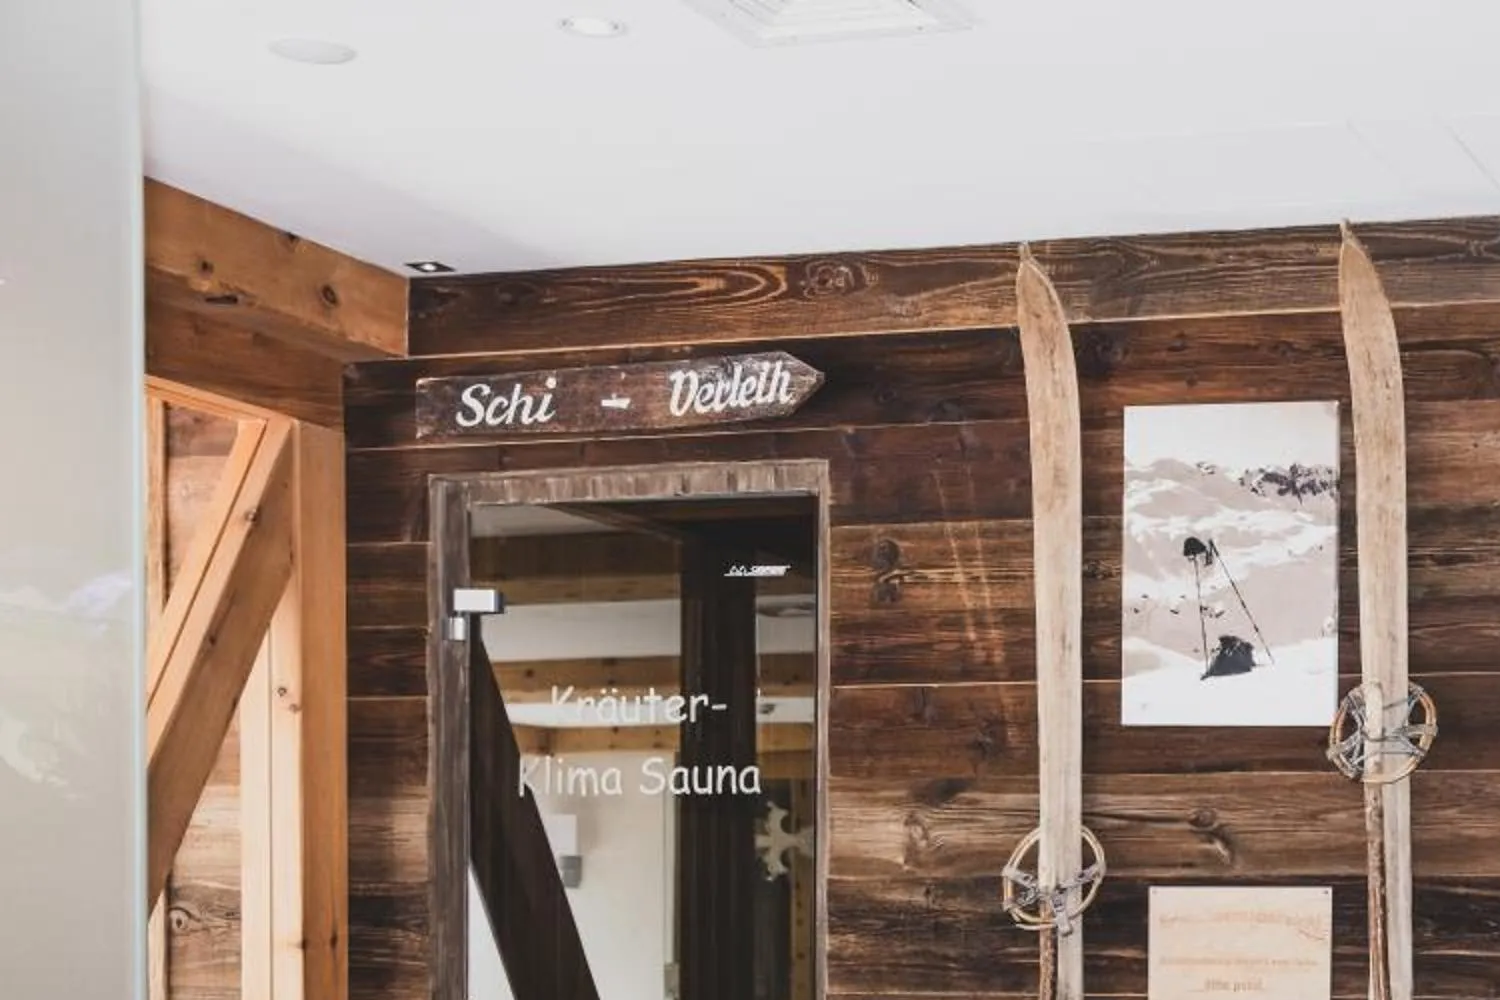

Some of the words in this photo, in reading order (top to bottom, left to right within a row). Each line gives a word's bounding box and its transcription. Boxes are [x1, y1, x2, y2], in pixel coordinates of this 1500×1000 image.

[455, 376, 557, 427] Schi
[668, 359, 795, 417] Verleih
[551, 684, 728, 724] Kräuter-
[517, 754, 623, 798] Klima
[639, 756, 762, 796] Sauna
